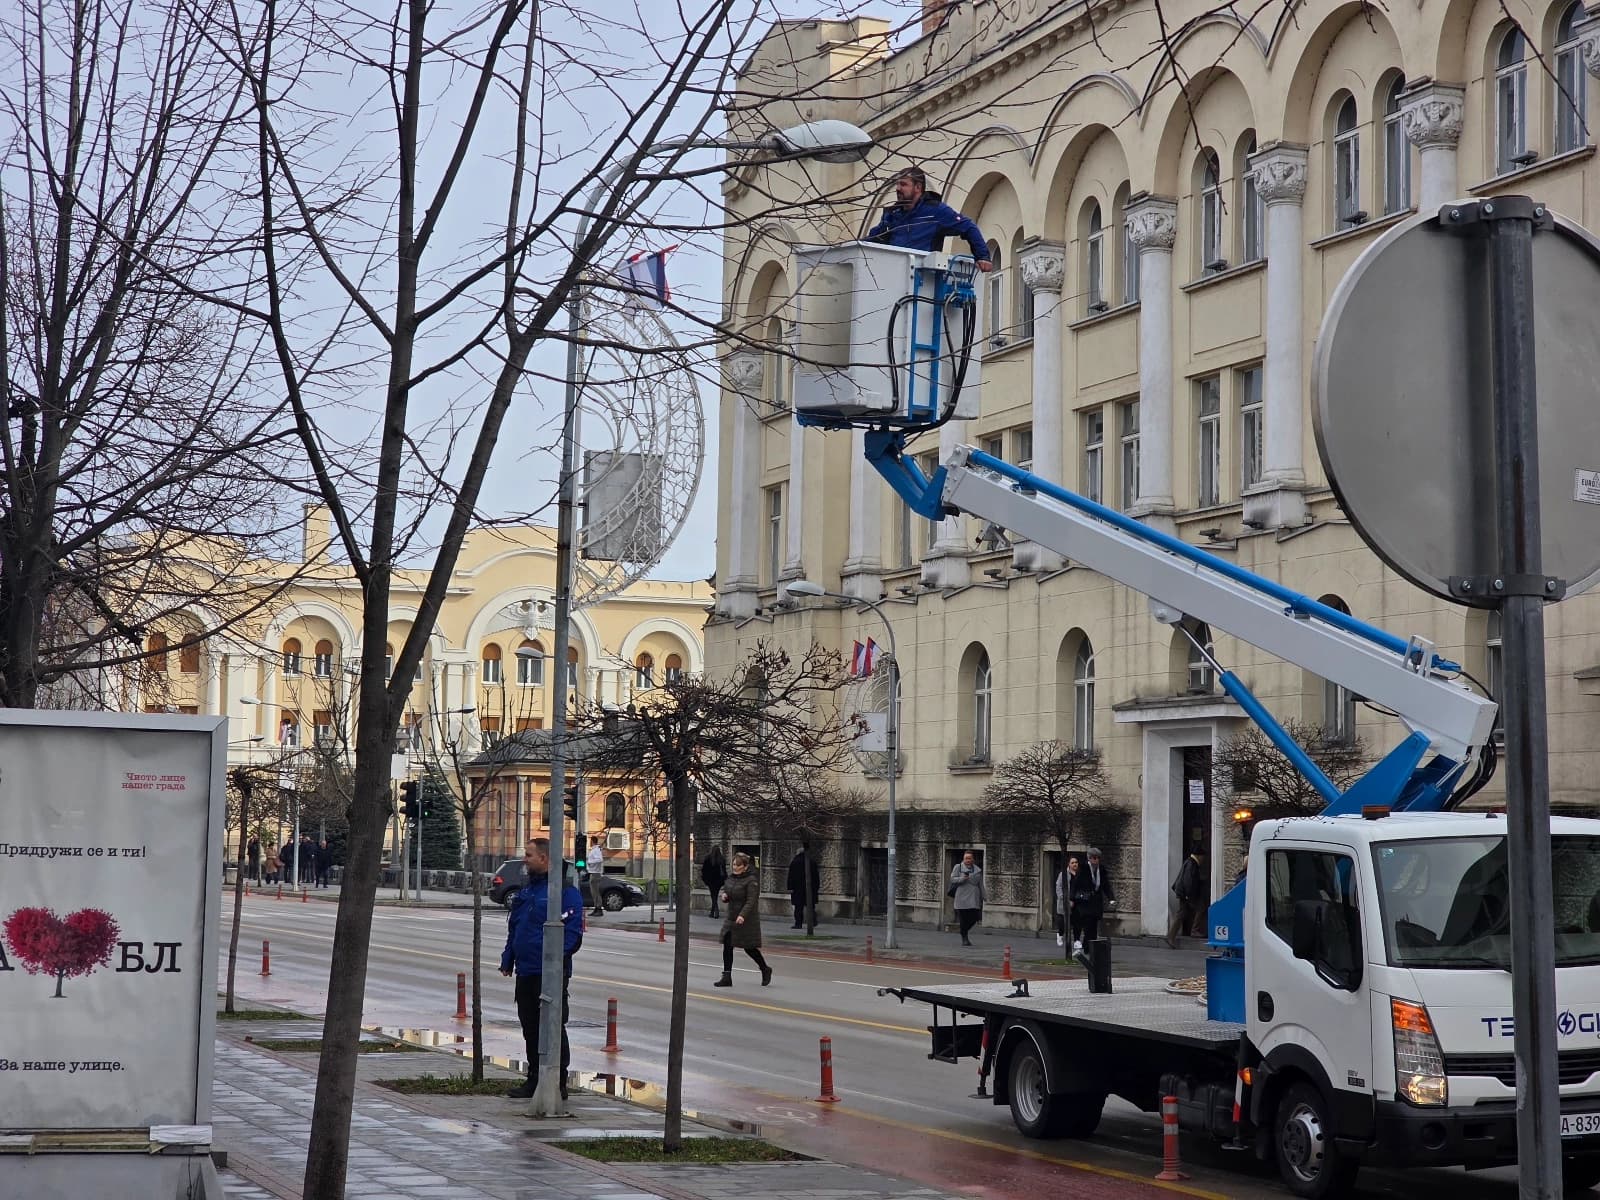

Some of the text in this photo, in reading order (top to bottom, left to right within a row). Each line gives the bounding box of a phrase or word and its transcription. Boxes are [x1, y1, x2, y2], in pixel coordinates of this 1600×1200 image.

[127, 772, 186, 783] Чисто лице
[156, 783, 186, 791] града
[0, 843, 146, 859] Придружи се и ти!
[115, 941, 183, 973] БЛ
[0, 1058, 125, 1074] За наше улице.
[1561, 1115, 1600, 1133] A-839
